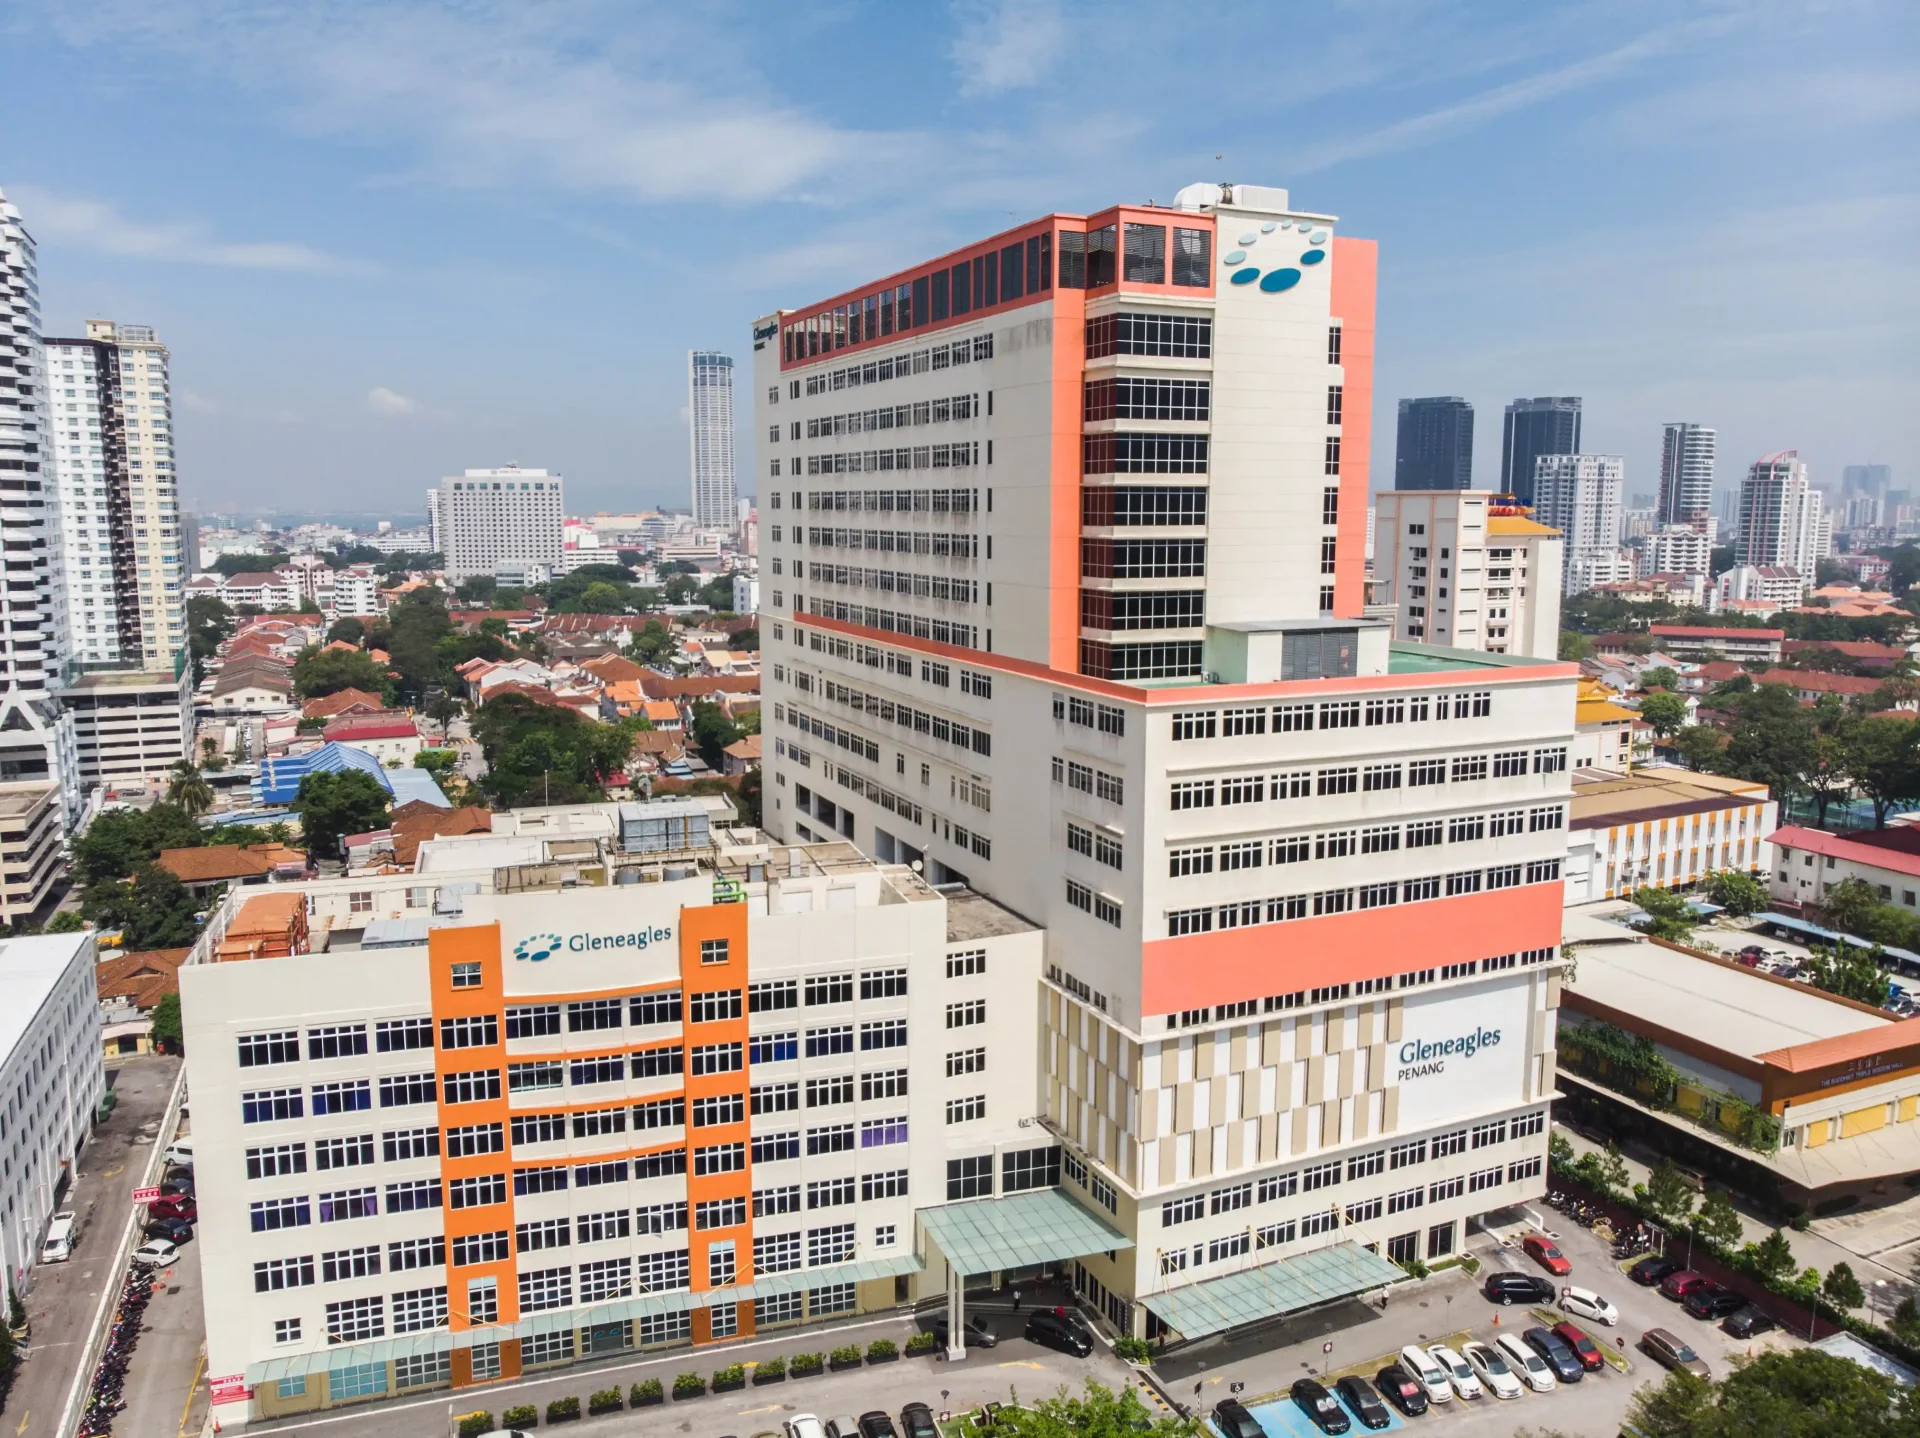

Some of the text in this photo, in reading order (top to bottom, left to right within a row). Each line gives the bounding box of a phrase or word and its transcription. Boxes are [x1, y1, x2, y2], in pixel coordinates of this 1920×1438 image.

[569, 926, 672, 952] Gleneagles
[1399, 1026, 1501, 1064] Gleneagles
[1398, 1061, 1445, 1081] PENANG
